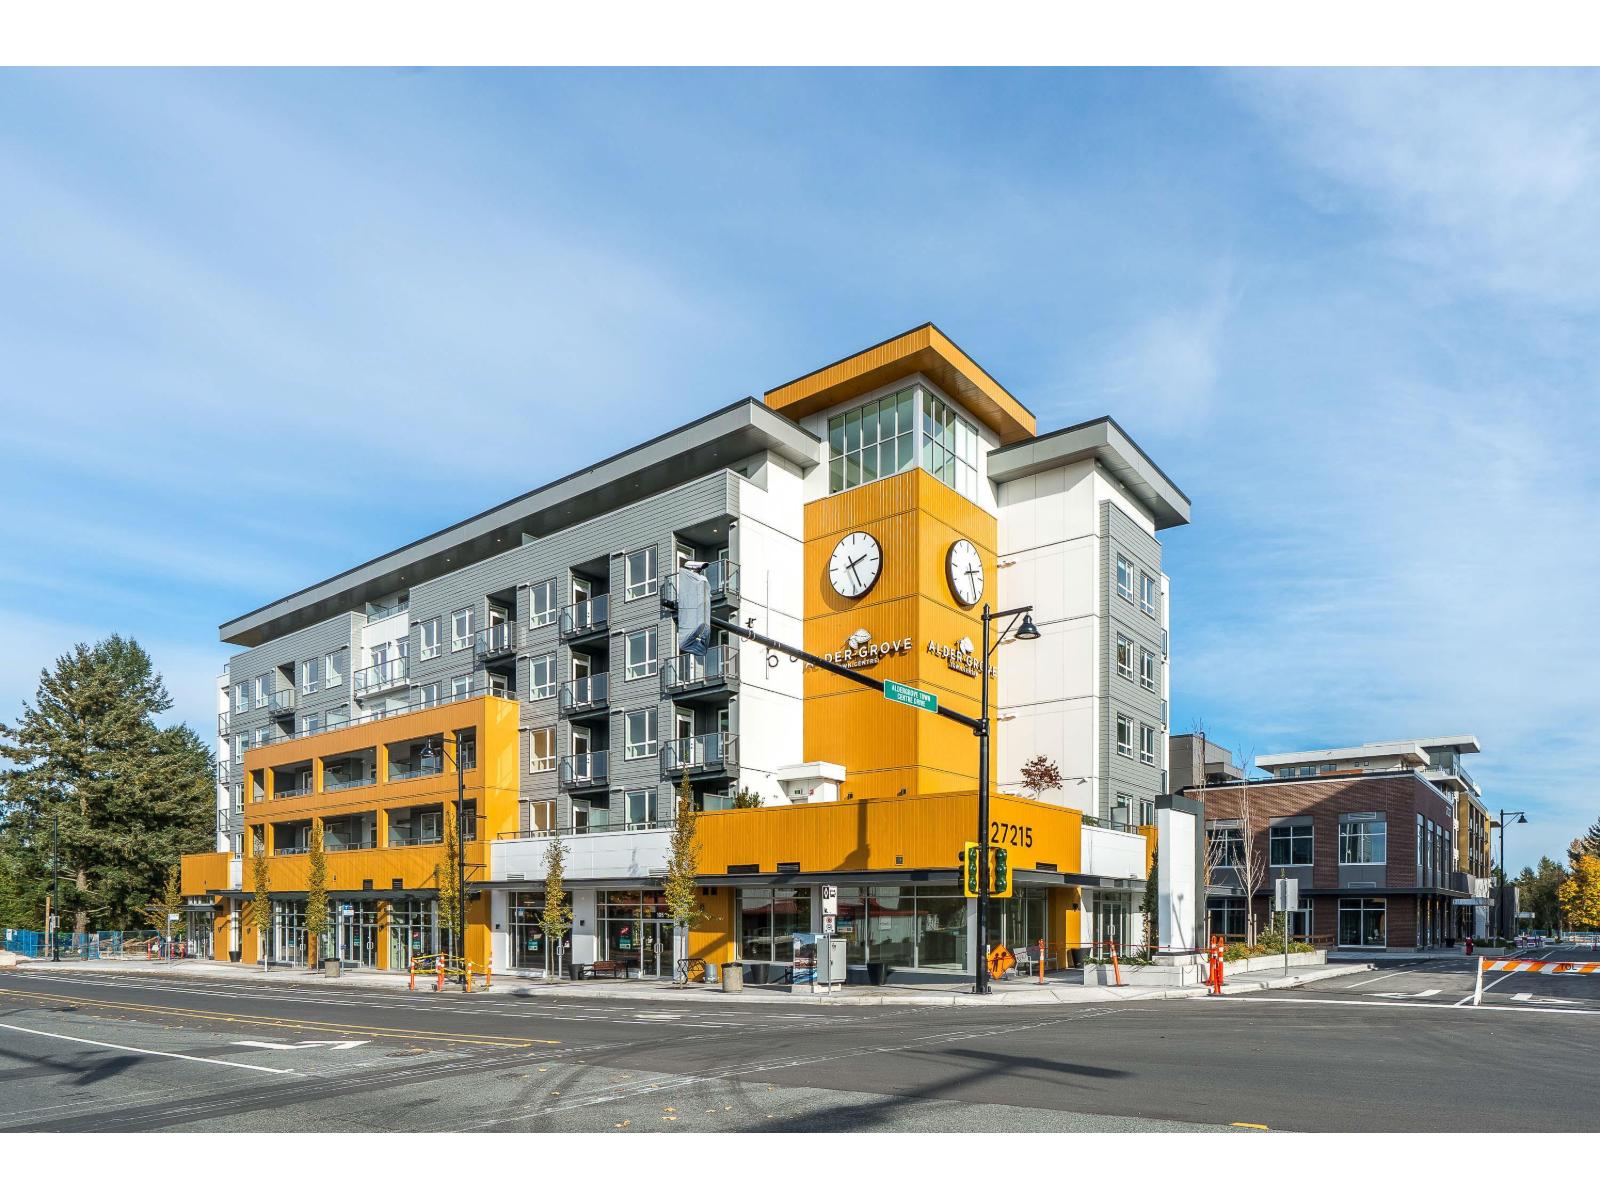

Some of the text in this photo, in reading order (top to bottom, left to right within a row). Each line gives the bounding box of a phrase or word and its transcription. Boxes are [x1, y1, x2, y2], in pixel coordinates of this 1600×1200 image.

[859, 637, 912, 658] GROVE
[928, 640, 962, 663] ALDER
[891, 684, 931, 702] ALDERGROVE TOWN
[897, 693, 926, 708] CENTRE DRIVE
[991, 822, 1033, 848] 27215
